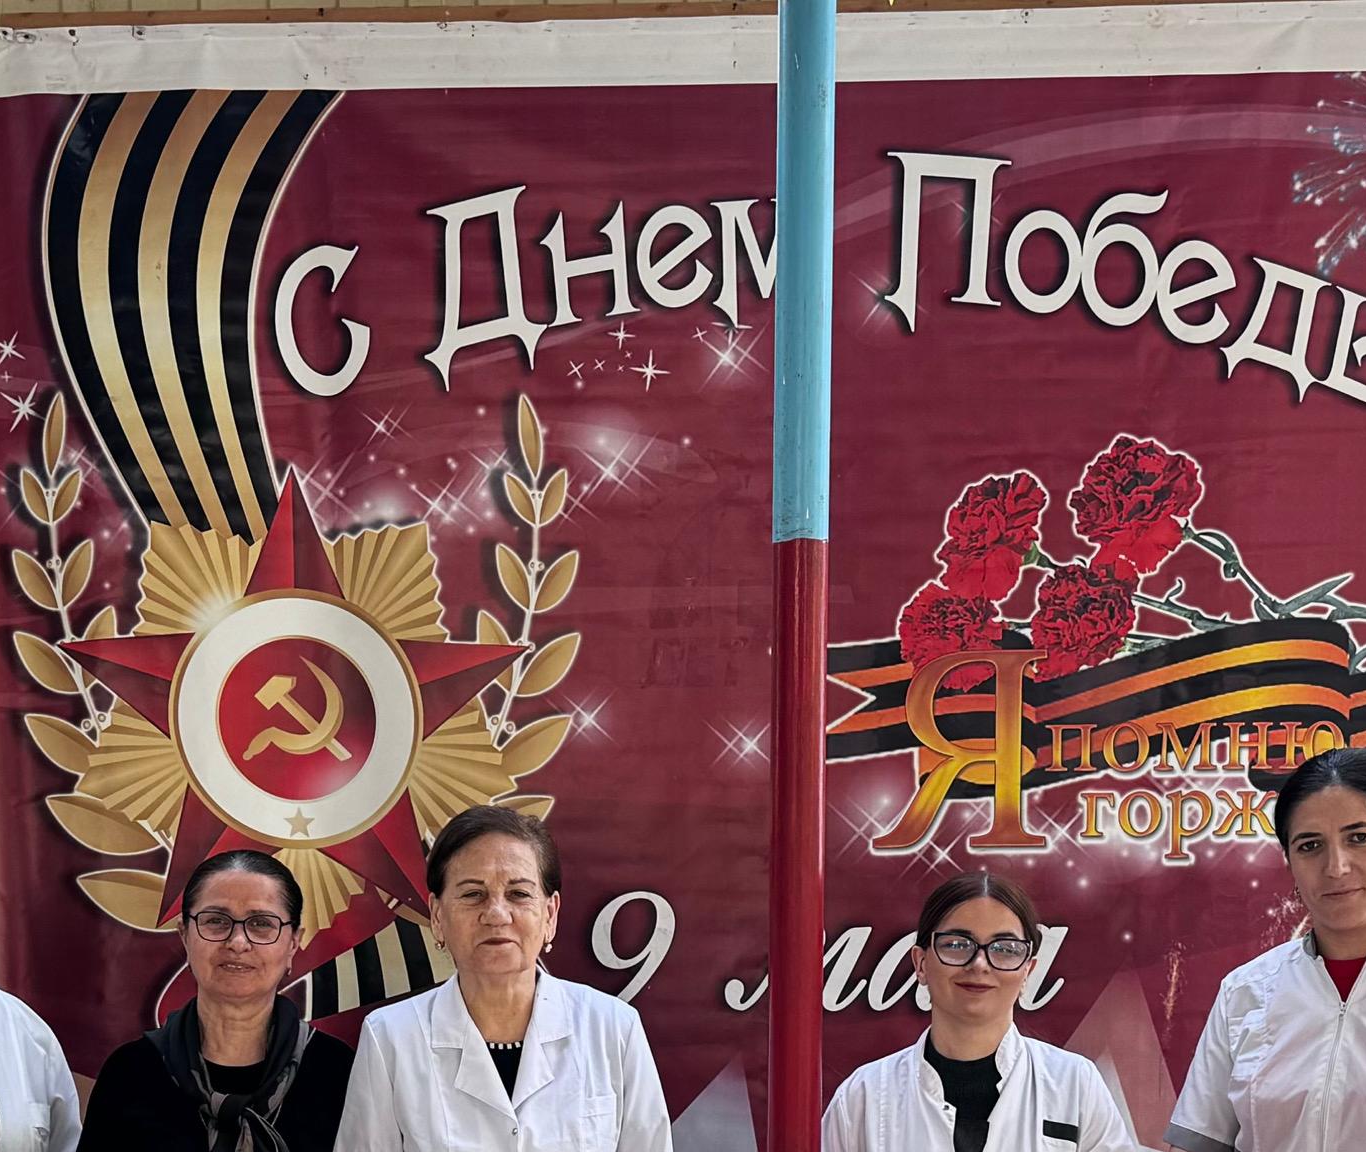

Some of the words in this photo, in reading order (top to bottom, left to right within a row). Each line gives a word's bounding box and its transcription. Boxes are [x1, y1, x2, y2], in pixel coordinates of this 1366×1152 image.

[424, 184, 777, 393] Днем
[872, 648, 1047, 849] Я
[1046, 719, 1346, 774] помню
[591, 890, 676, 1003] 9
